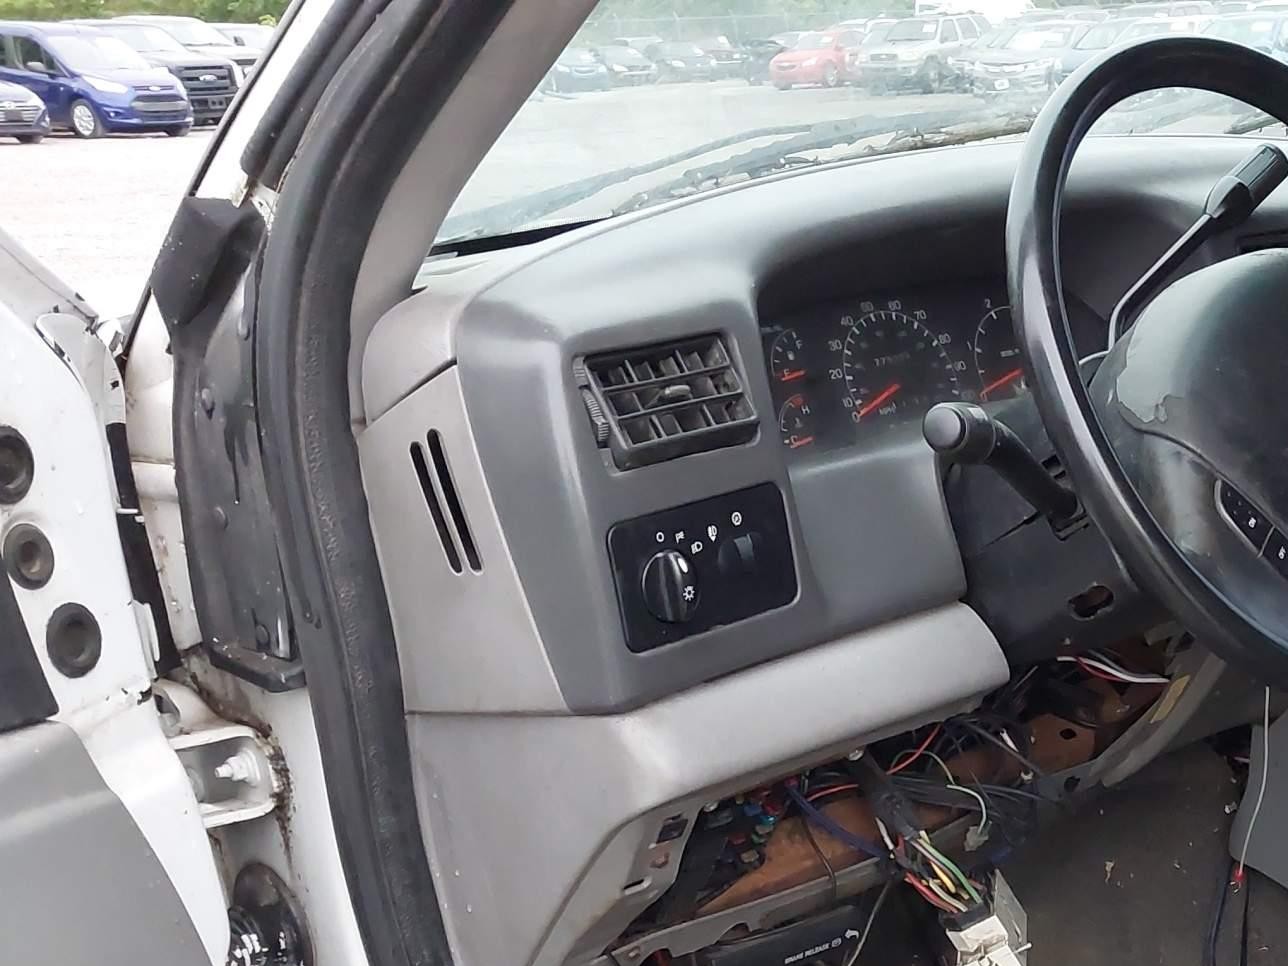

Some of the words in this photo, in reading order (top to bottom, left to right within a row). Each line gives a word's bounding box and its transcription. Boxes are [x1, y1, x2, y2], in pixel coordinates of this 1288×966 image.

[913, 310, 927, 320] 70
[840, 316, 854, 326] 40
[828, 340, 843, 352] 30
[829, 368, 843, 380] 20
[842, 397, 854, 408] 10
[801, 405, 811, 415] H
